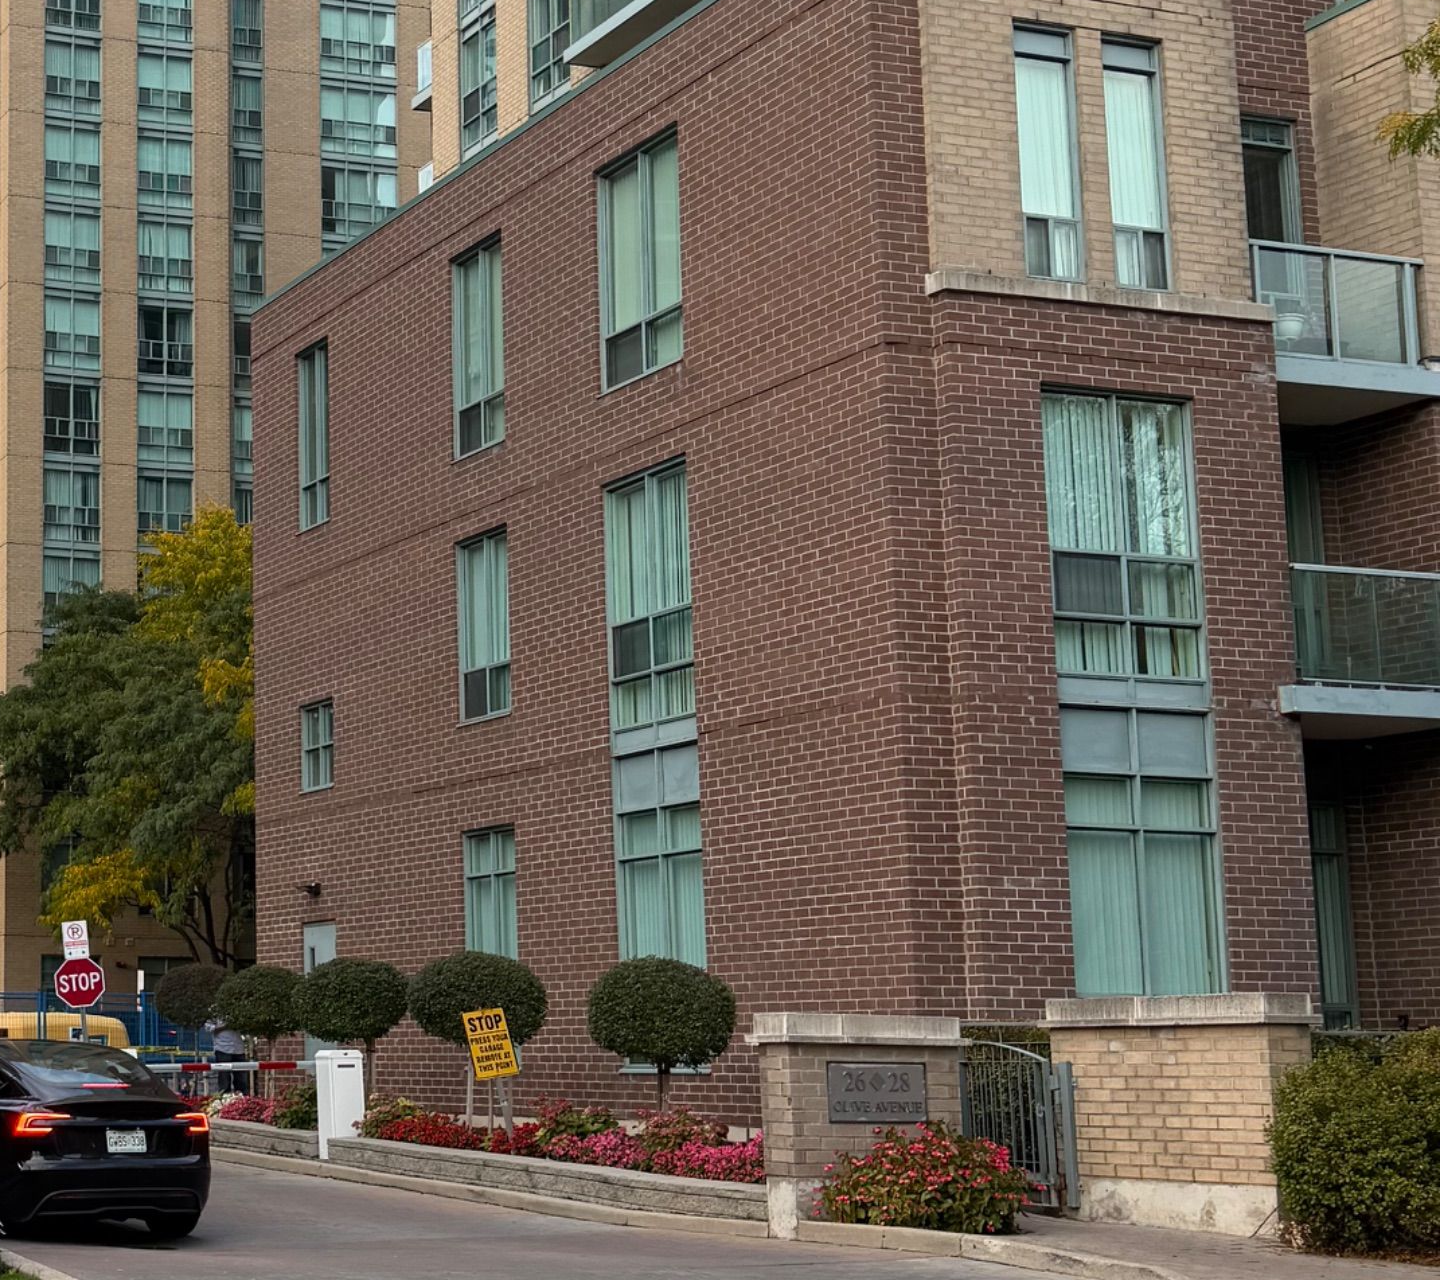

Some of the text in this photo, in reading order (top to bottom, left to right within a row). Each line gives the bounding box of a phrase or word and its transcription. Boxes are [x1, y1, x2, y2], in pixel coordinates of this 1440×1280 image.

[60, 972, 100, 993] STOP
[468, 1014, 502, 1032] STOP
[843, 1071, 910, 1092] 26 28
[833, 1101, 923, 1113] OLIVE AVENUE
